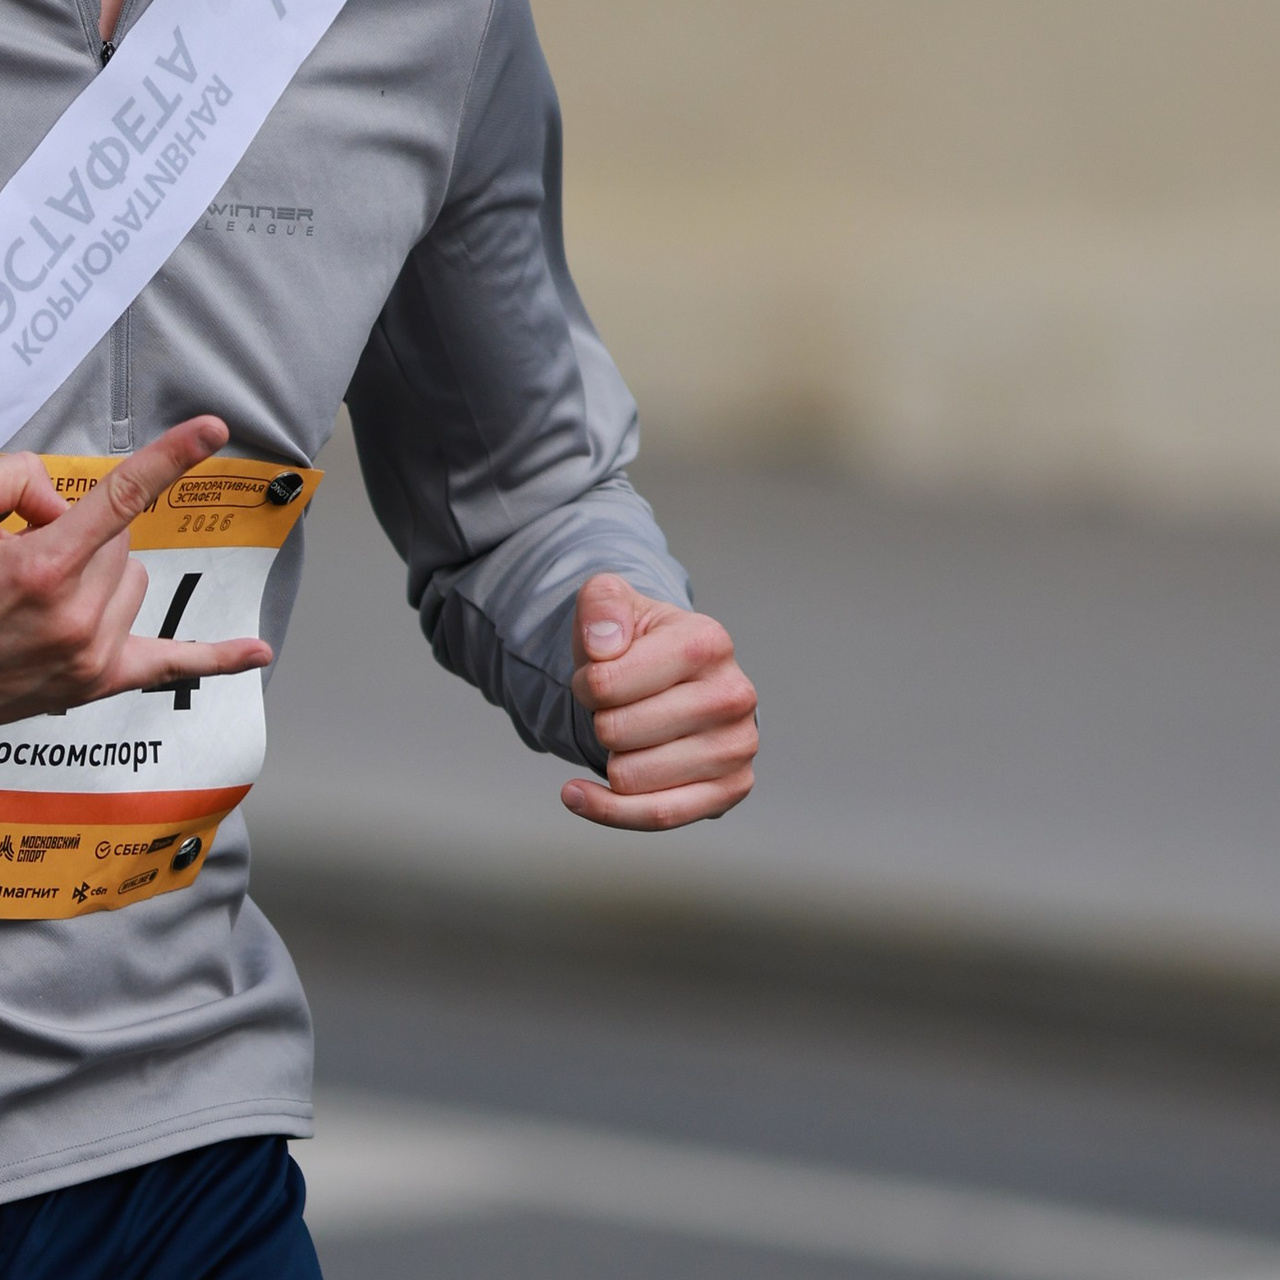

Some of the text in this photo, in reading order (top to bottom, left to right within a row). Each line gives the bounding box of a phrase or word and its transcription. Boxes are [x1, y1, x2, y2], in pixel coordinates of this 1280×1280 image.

[205, 220, 314, 236] LEAGUE
[179, 480, 265, 494] КОРПОРАТИВНАЯ
[175, 492, 221, 503] ЭСТАФЕТА
[177, 513, 234, 533] 2026
[19, 834, 81, 850] МОСКОВСКИЙ
[16, 849, 47, 863] СПОРТ
[113, 843, 149, 857] СБЕР
